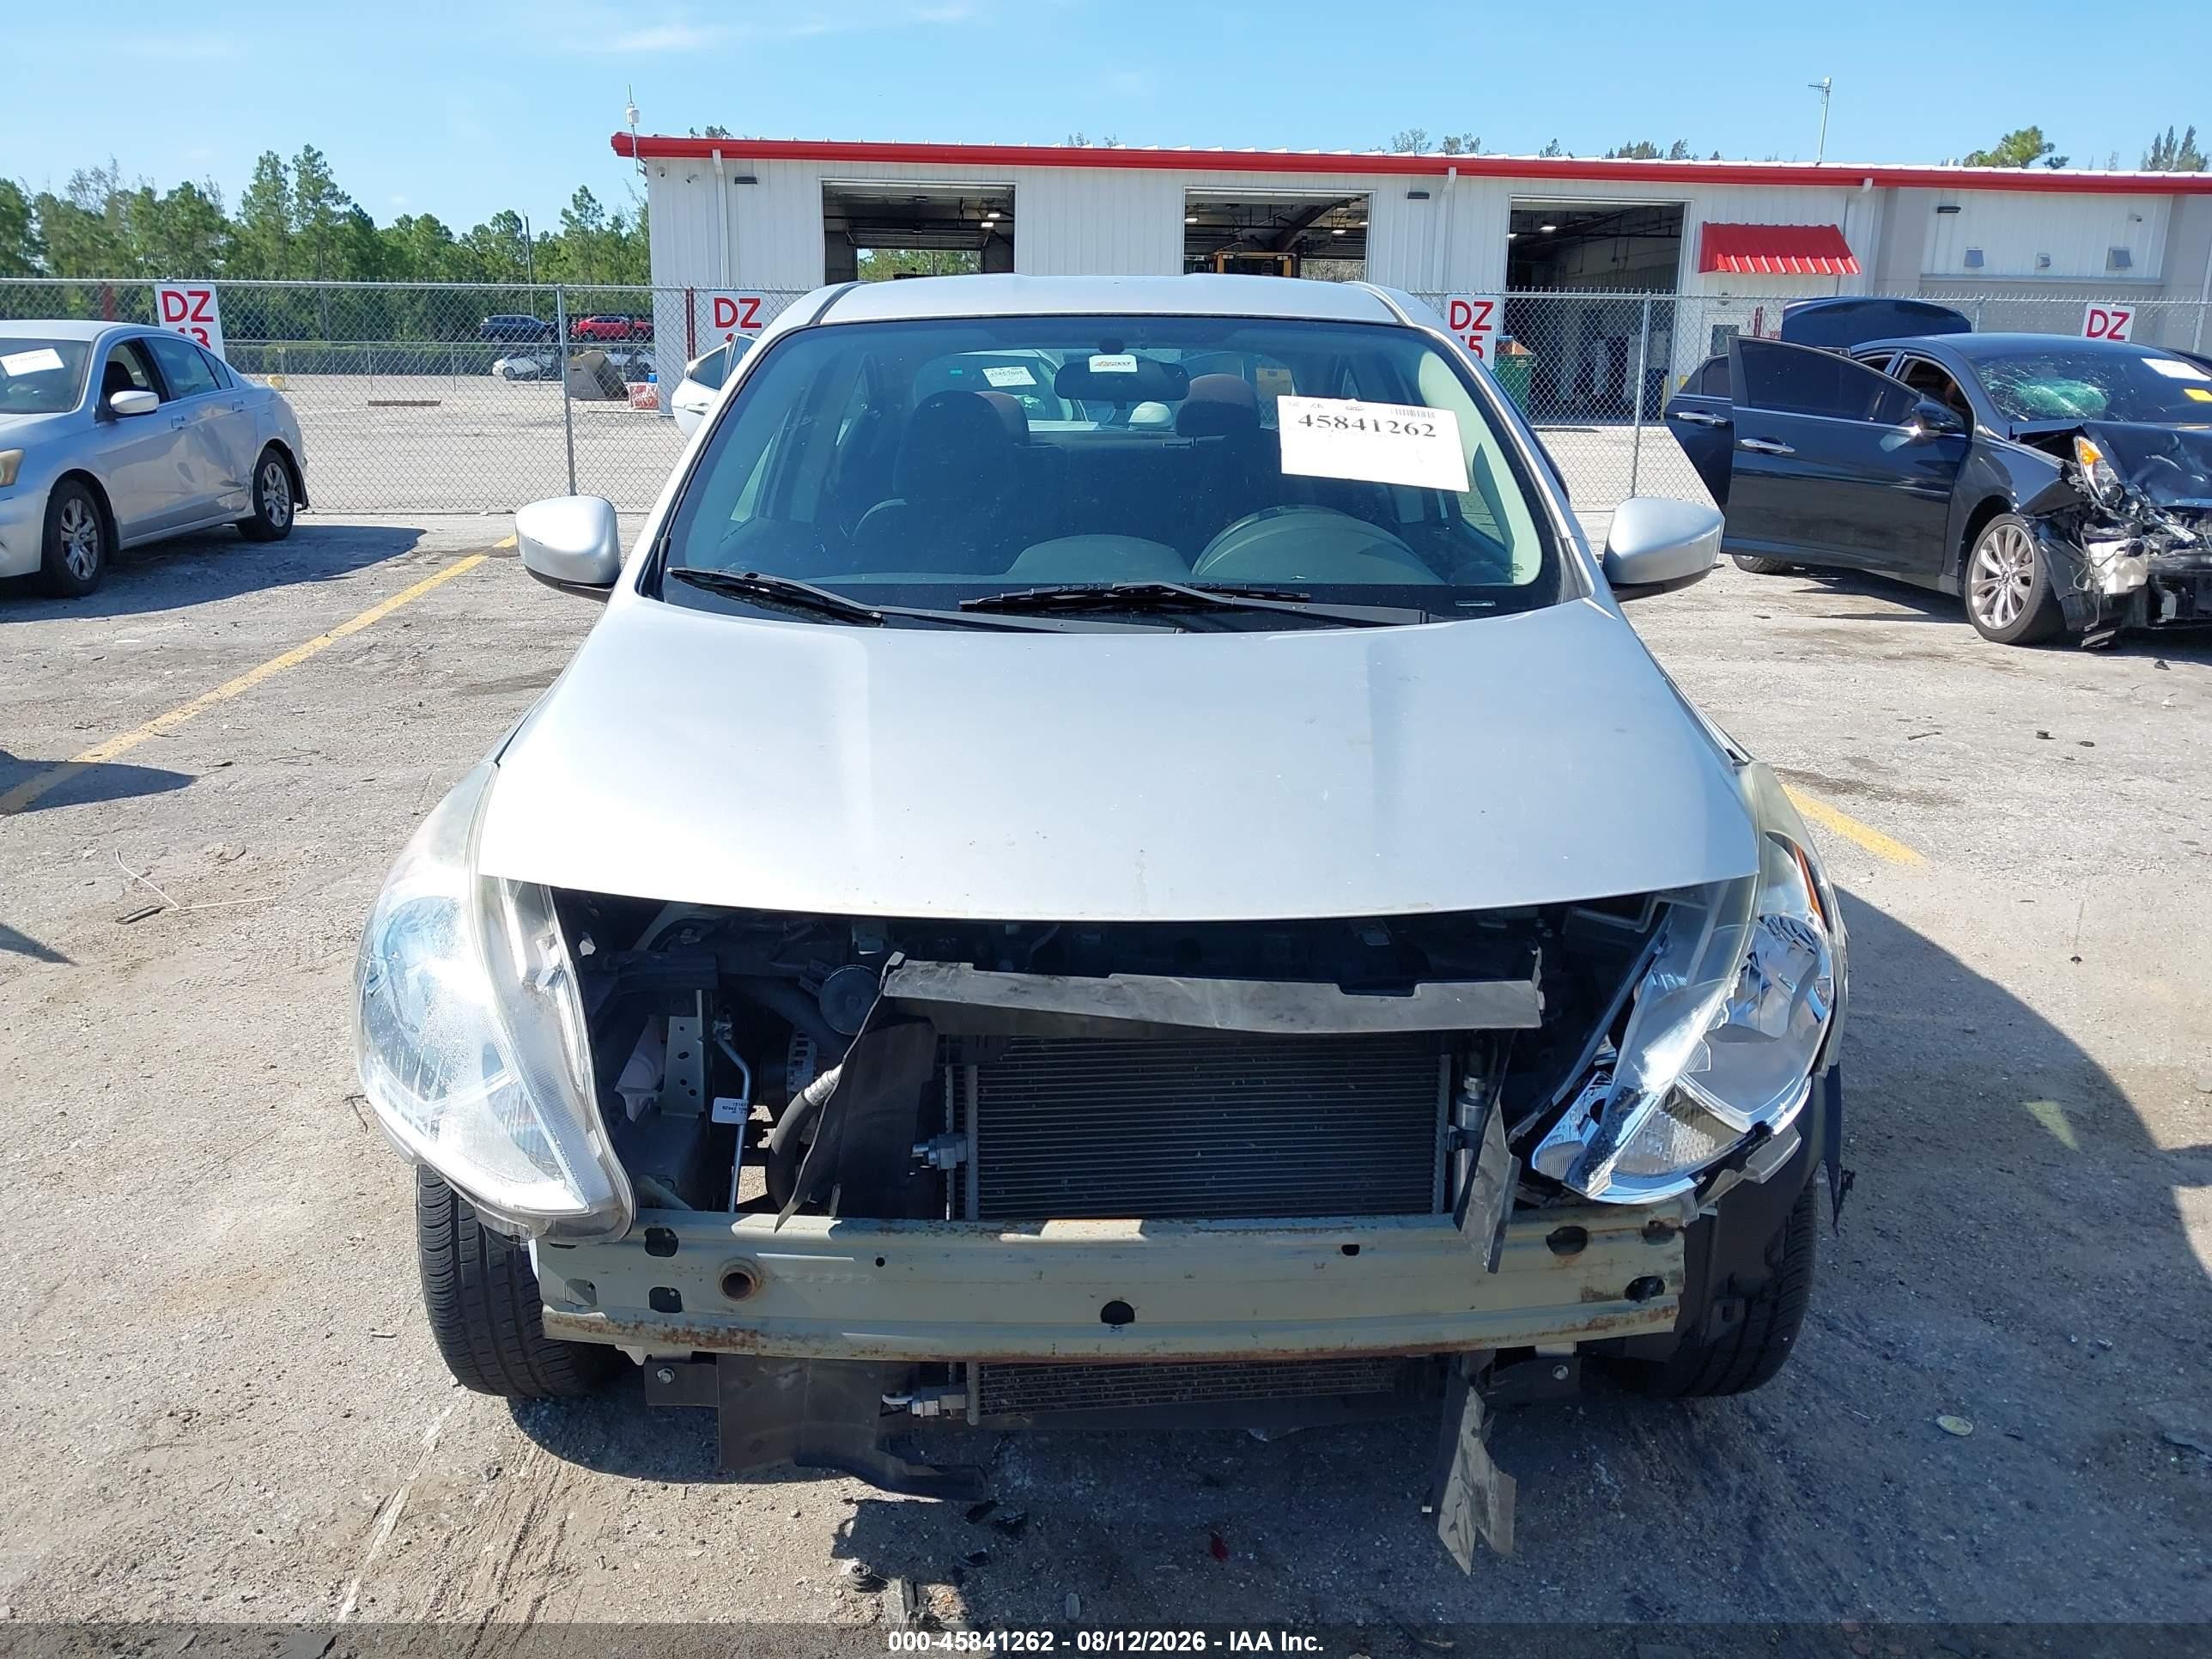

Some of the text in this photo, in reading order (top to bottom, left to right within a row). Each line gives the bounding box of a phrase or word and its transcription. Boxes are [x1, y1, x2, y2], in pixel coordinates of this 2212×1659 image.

[161, 291, 214, 322] DZ
[714, 297, 762, 328] DZ
[1449, 301, 1494, 331] DZ
[178, 327, 211, 349] 3
[2087, 309, 2130, 340] DZ
[1460, 336, 1484, 359] 5
[1298, 414, 1437, 437] 45841262
